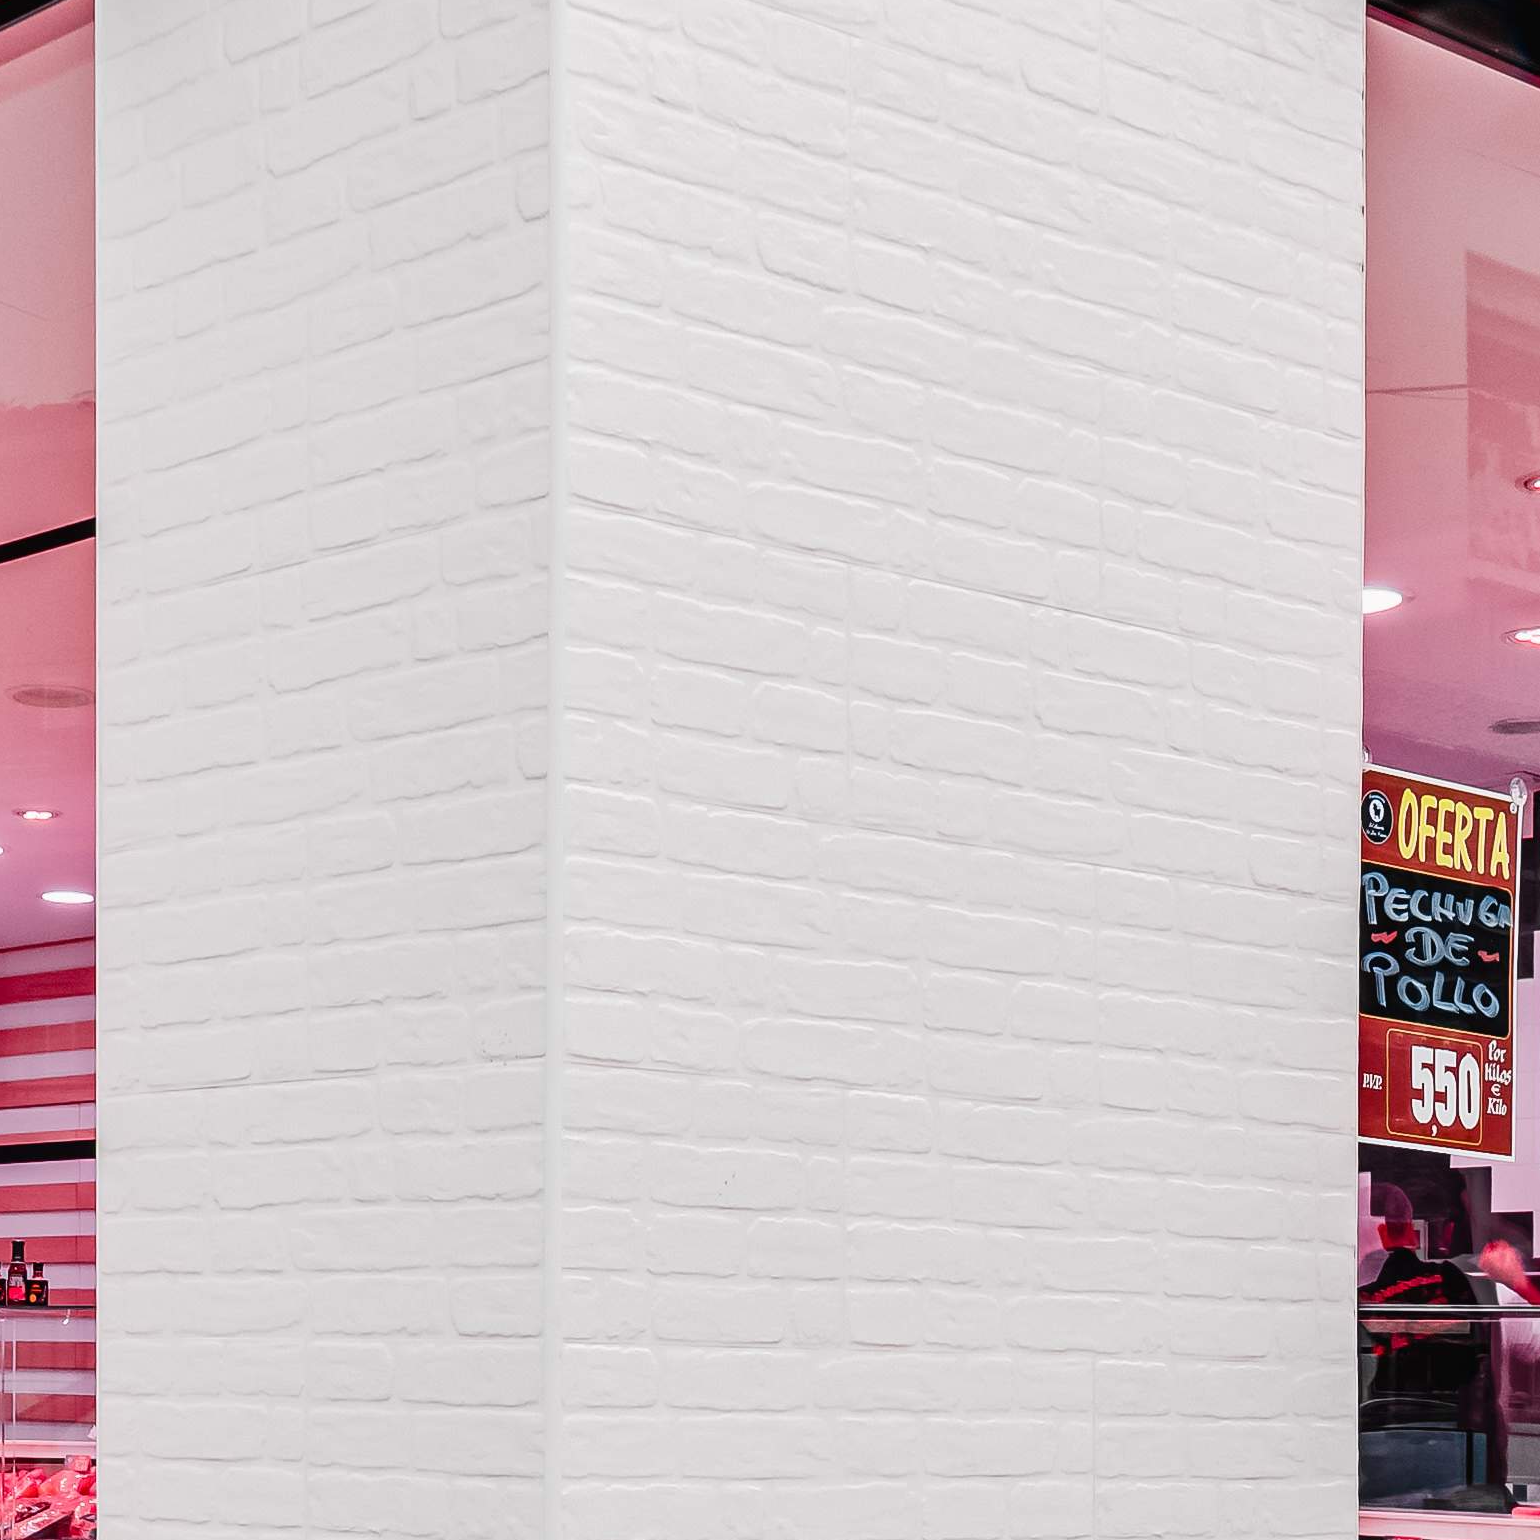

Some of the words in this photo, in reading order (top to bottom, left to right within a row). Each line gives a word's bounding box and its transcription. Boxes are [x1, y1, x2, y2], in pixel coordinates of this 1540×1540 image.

[1397, 788, 1510, 880] OFERTA
[1361, 871, 1513, 929] PECHUGA
[1405, 926, 1474, 966] DE
[1361, 951, 1499, 1019] POLLO
[1488, 1040, 1506, 1062] Por
[1411, 1045, 1481, 1137] 5,50
[1487, 1097, 1507, 1116] Kilo
[1491, 1084, 1501, 1096] €
